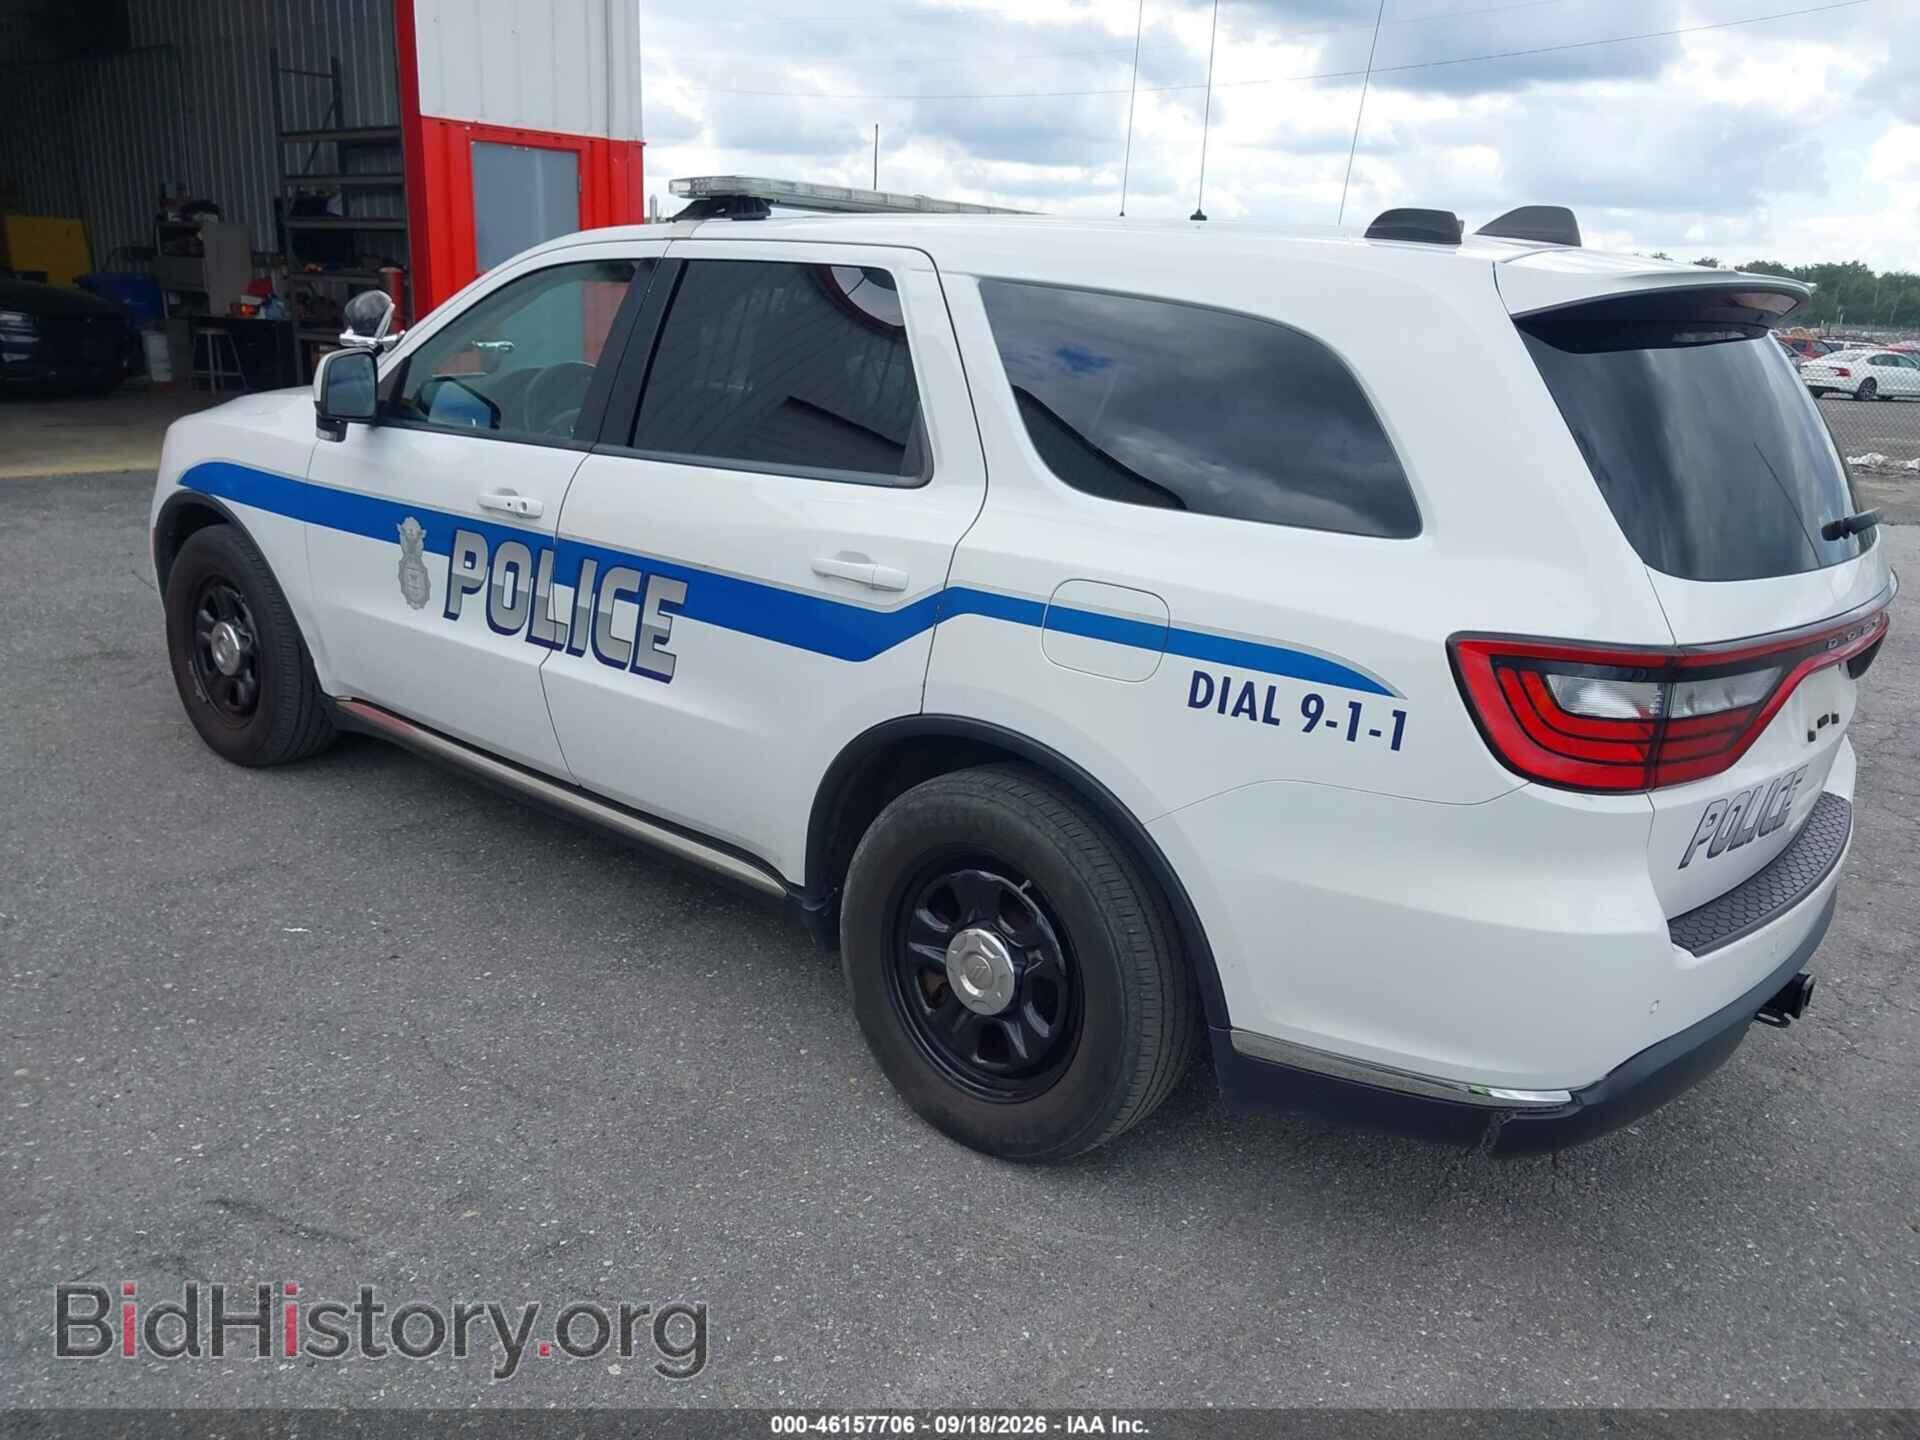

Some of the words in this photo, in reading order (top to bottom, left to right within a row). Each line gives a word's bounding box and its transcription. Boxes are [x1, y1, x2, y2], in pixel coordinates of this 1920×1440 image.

[443, 528, 688, 684] POLICE
[1187, 669, 1280, 726] DIAL
[1300, 693, 1407, 751] 9-1-1
[1678, 764, 1808, 870] POLICE
